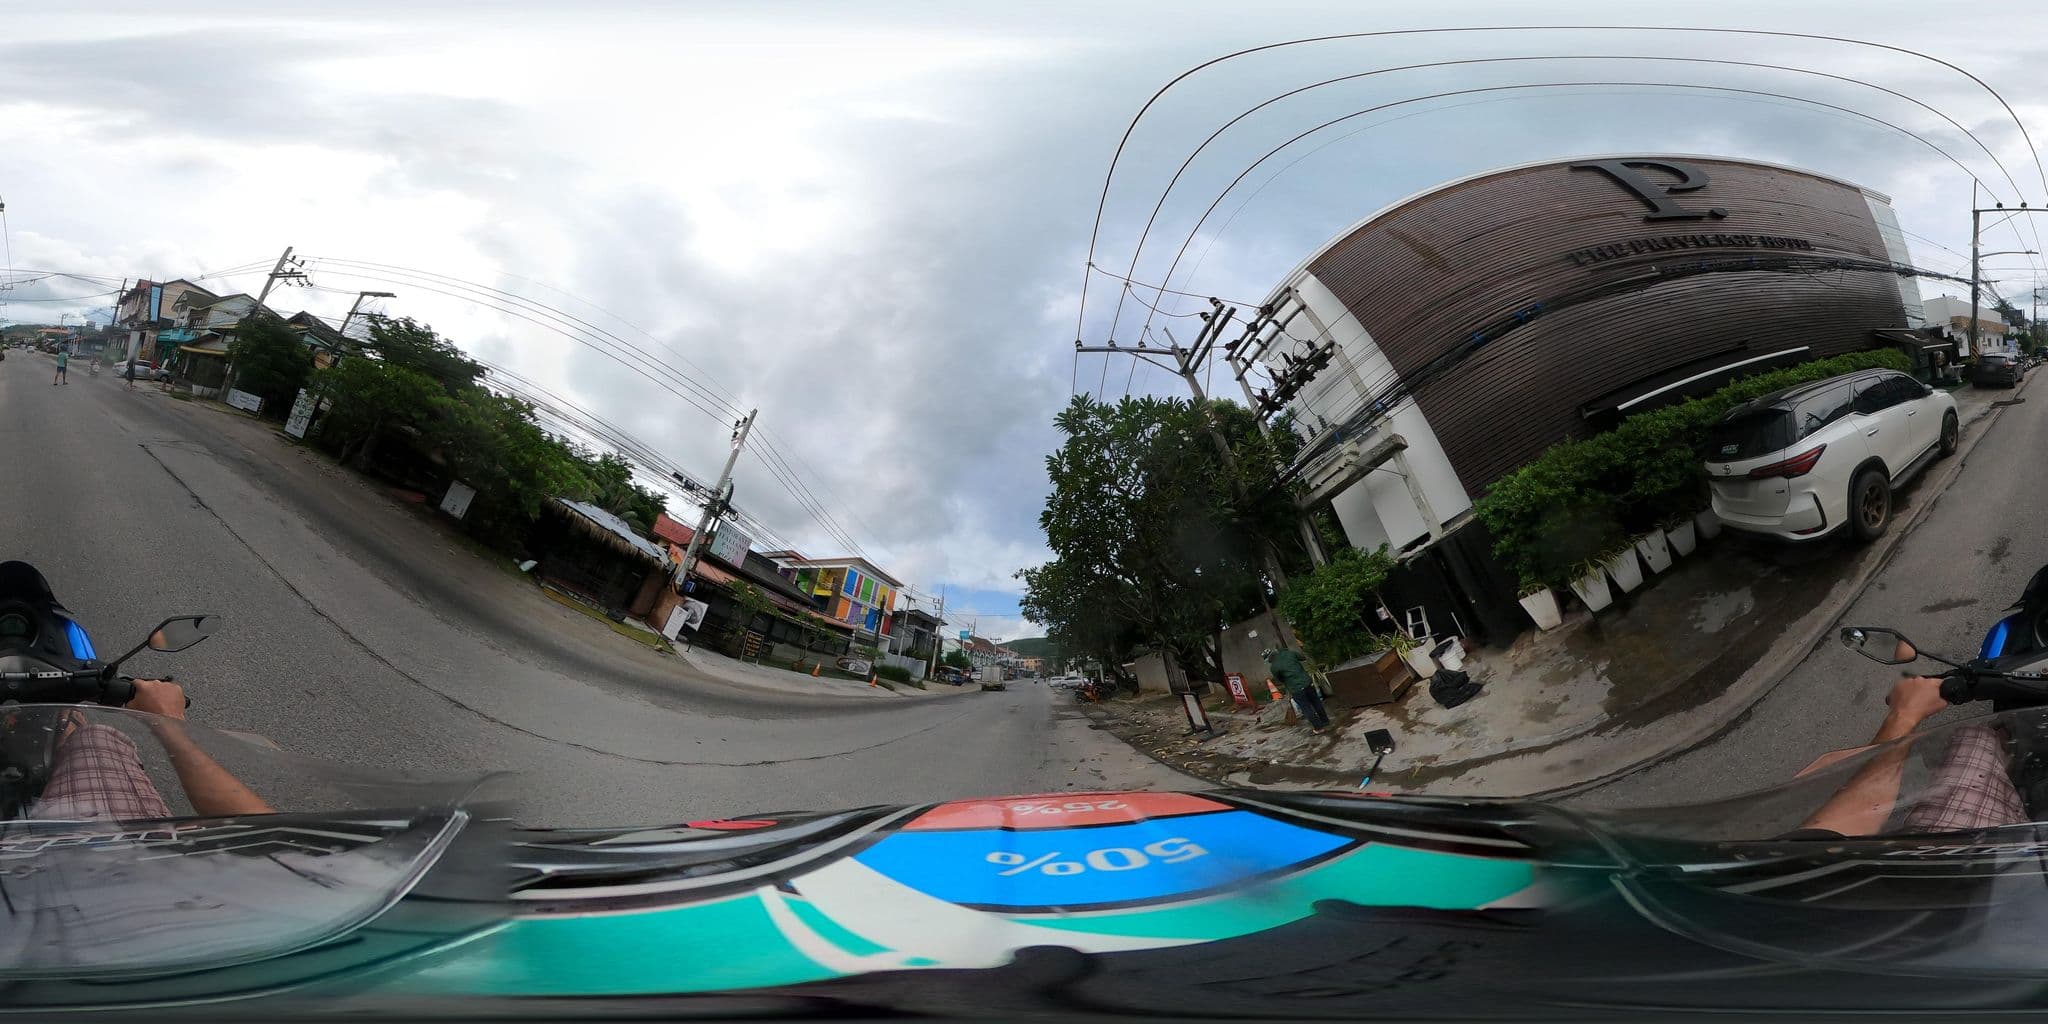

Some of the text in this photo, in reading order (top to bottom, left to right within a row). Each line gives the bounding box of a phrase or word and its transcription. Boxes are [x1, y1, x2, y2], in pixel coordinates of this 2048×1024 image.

[1567, 233, 1816, 265] THE PRIVILEGE HOTEL
[719, 532, 747, 553] ITALIANO
[1011, 800, 1129, 815] 25%
[985, 838, 1208, 876] 50%
